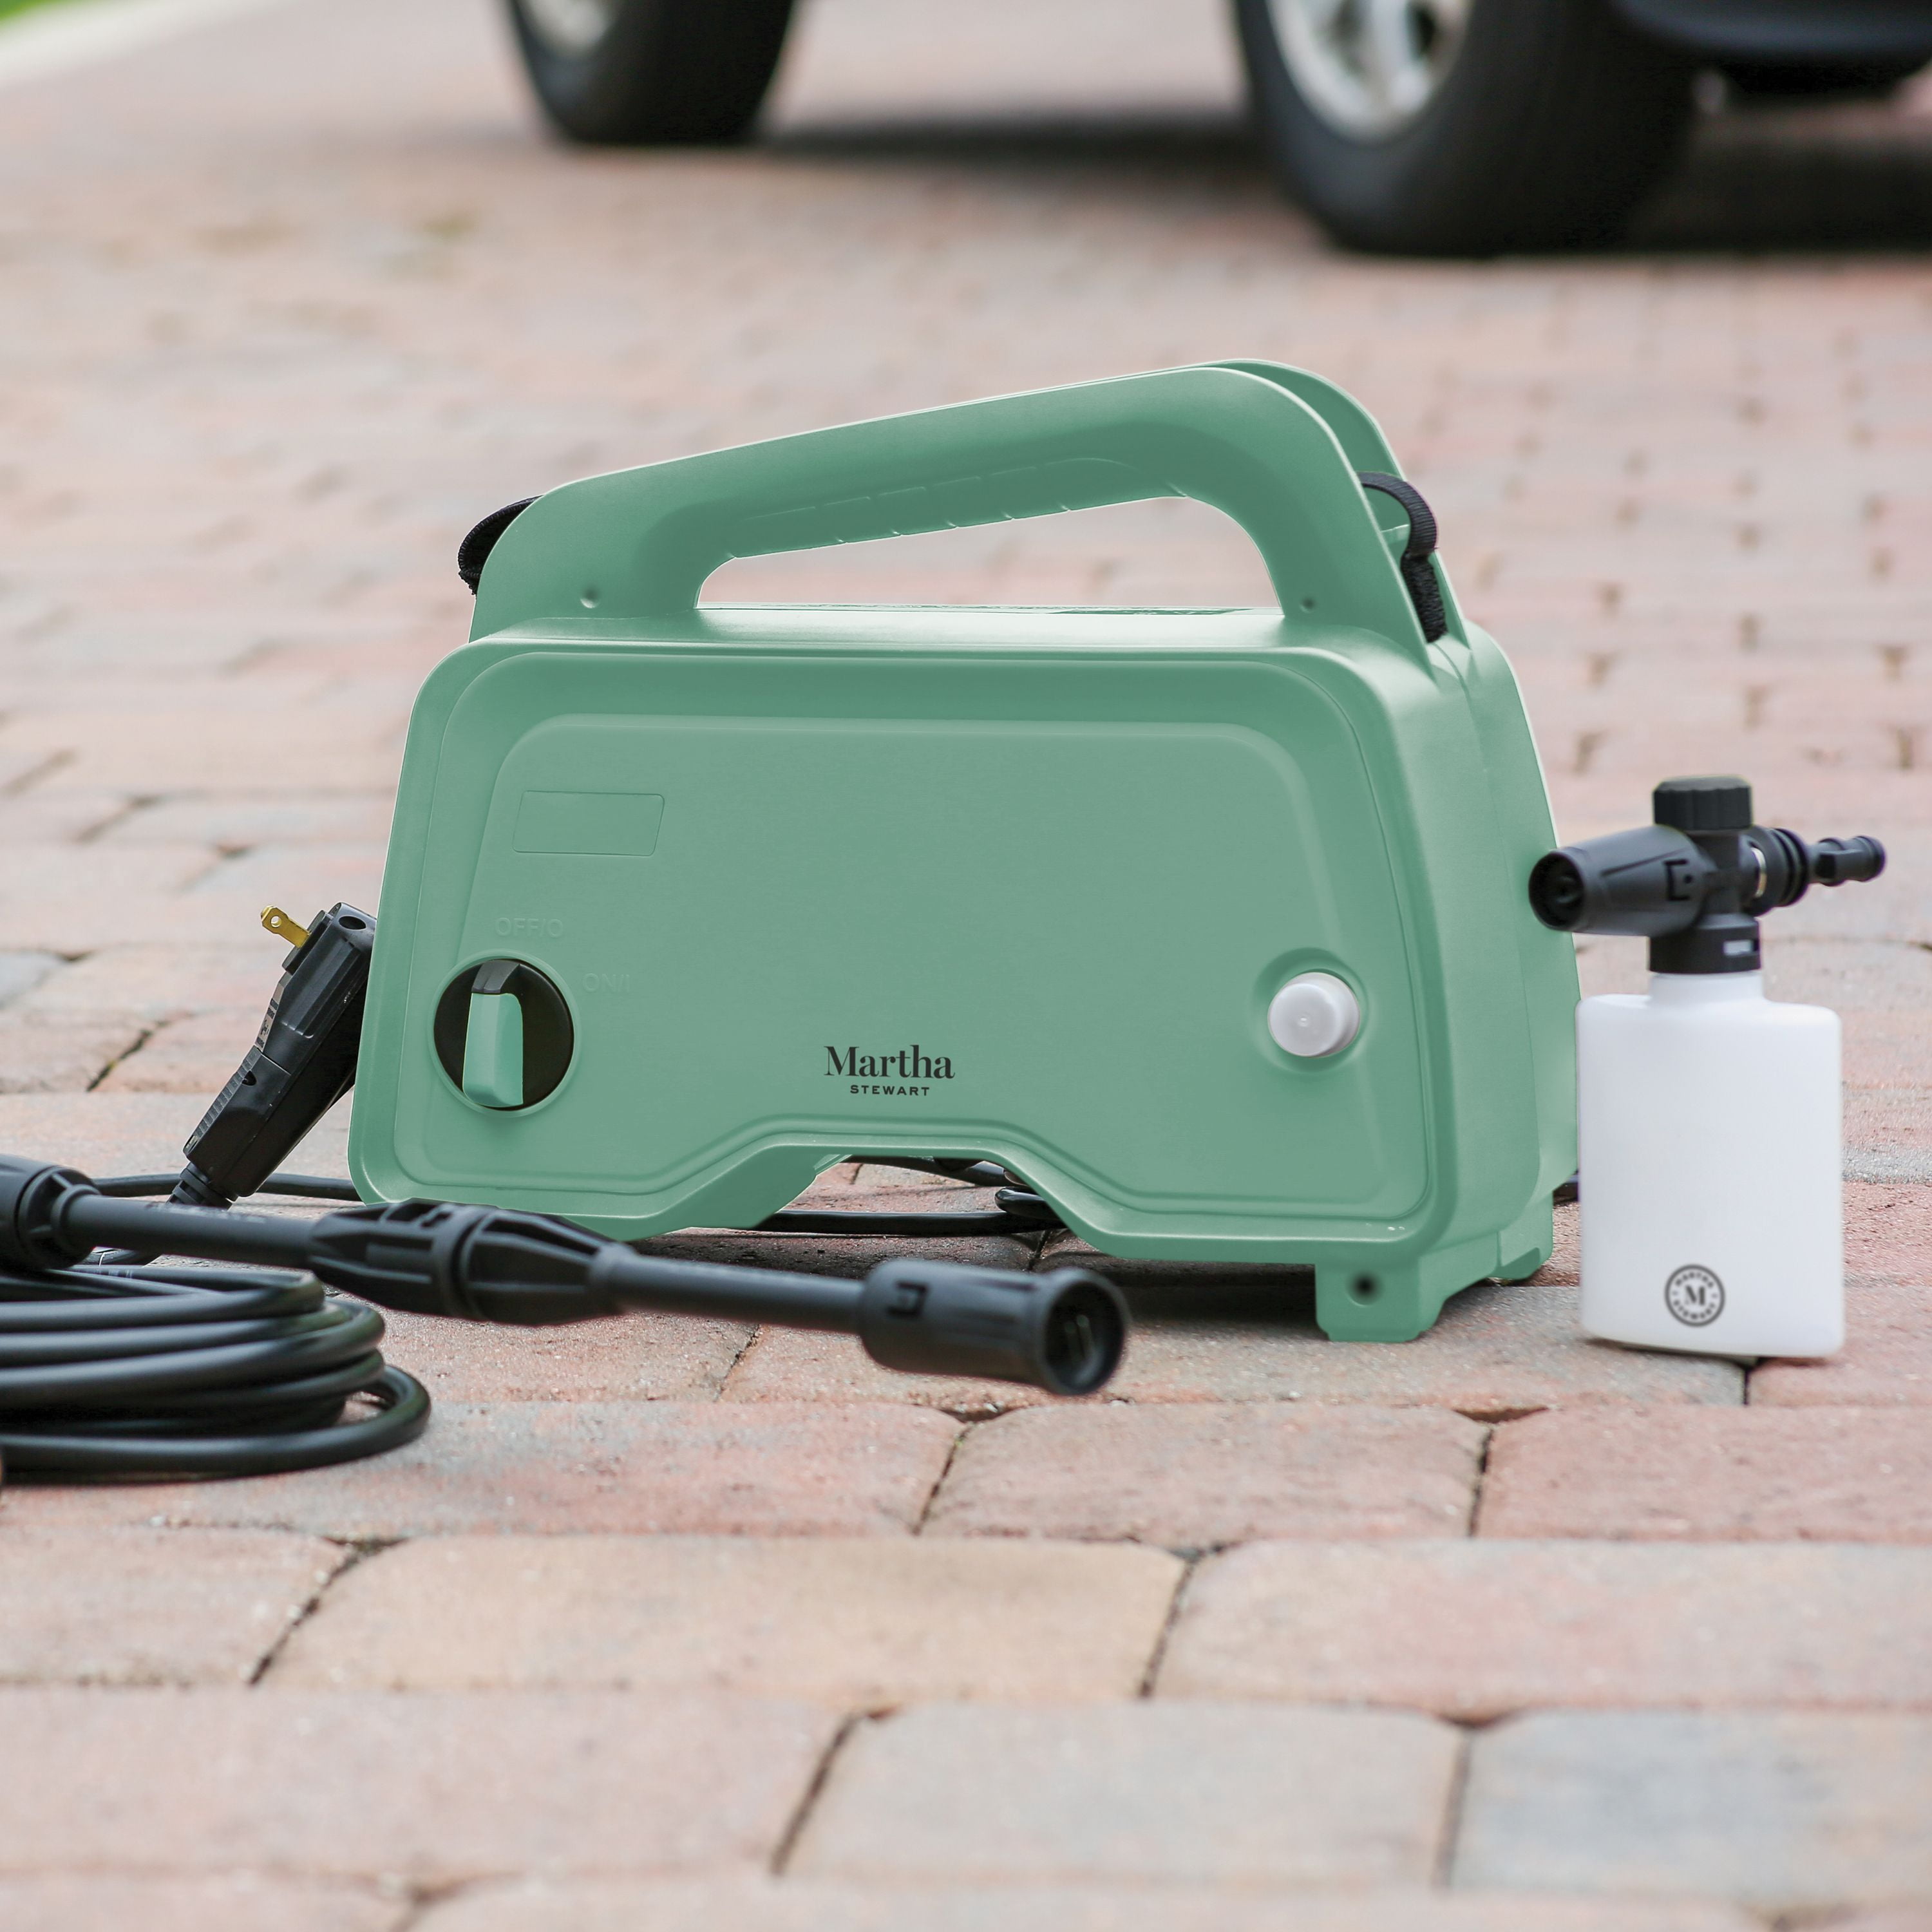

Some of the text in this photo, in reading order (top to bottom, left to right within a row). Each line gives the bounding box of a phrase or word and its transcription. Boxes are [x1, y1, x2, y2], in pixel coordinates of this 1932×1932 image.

[824, 1045, 956, 1079] Martha
[850, 1084, 929, 1096] STEWART
[1685, 1285, 1706, 1306] M
